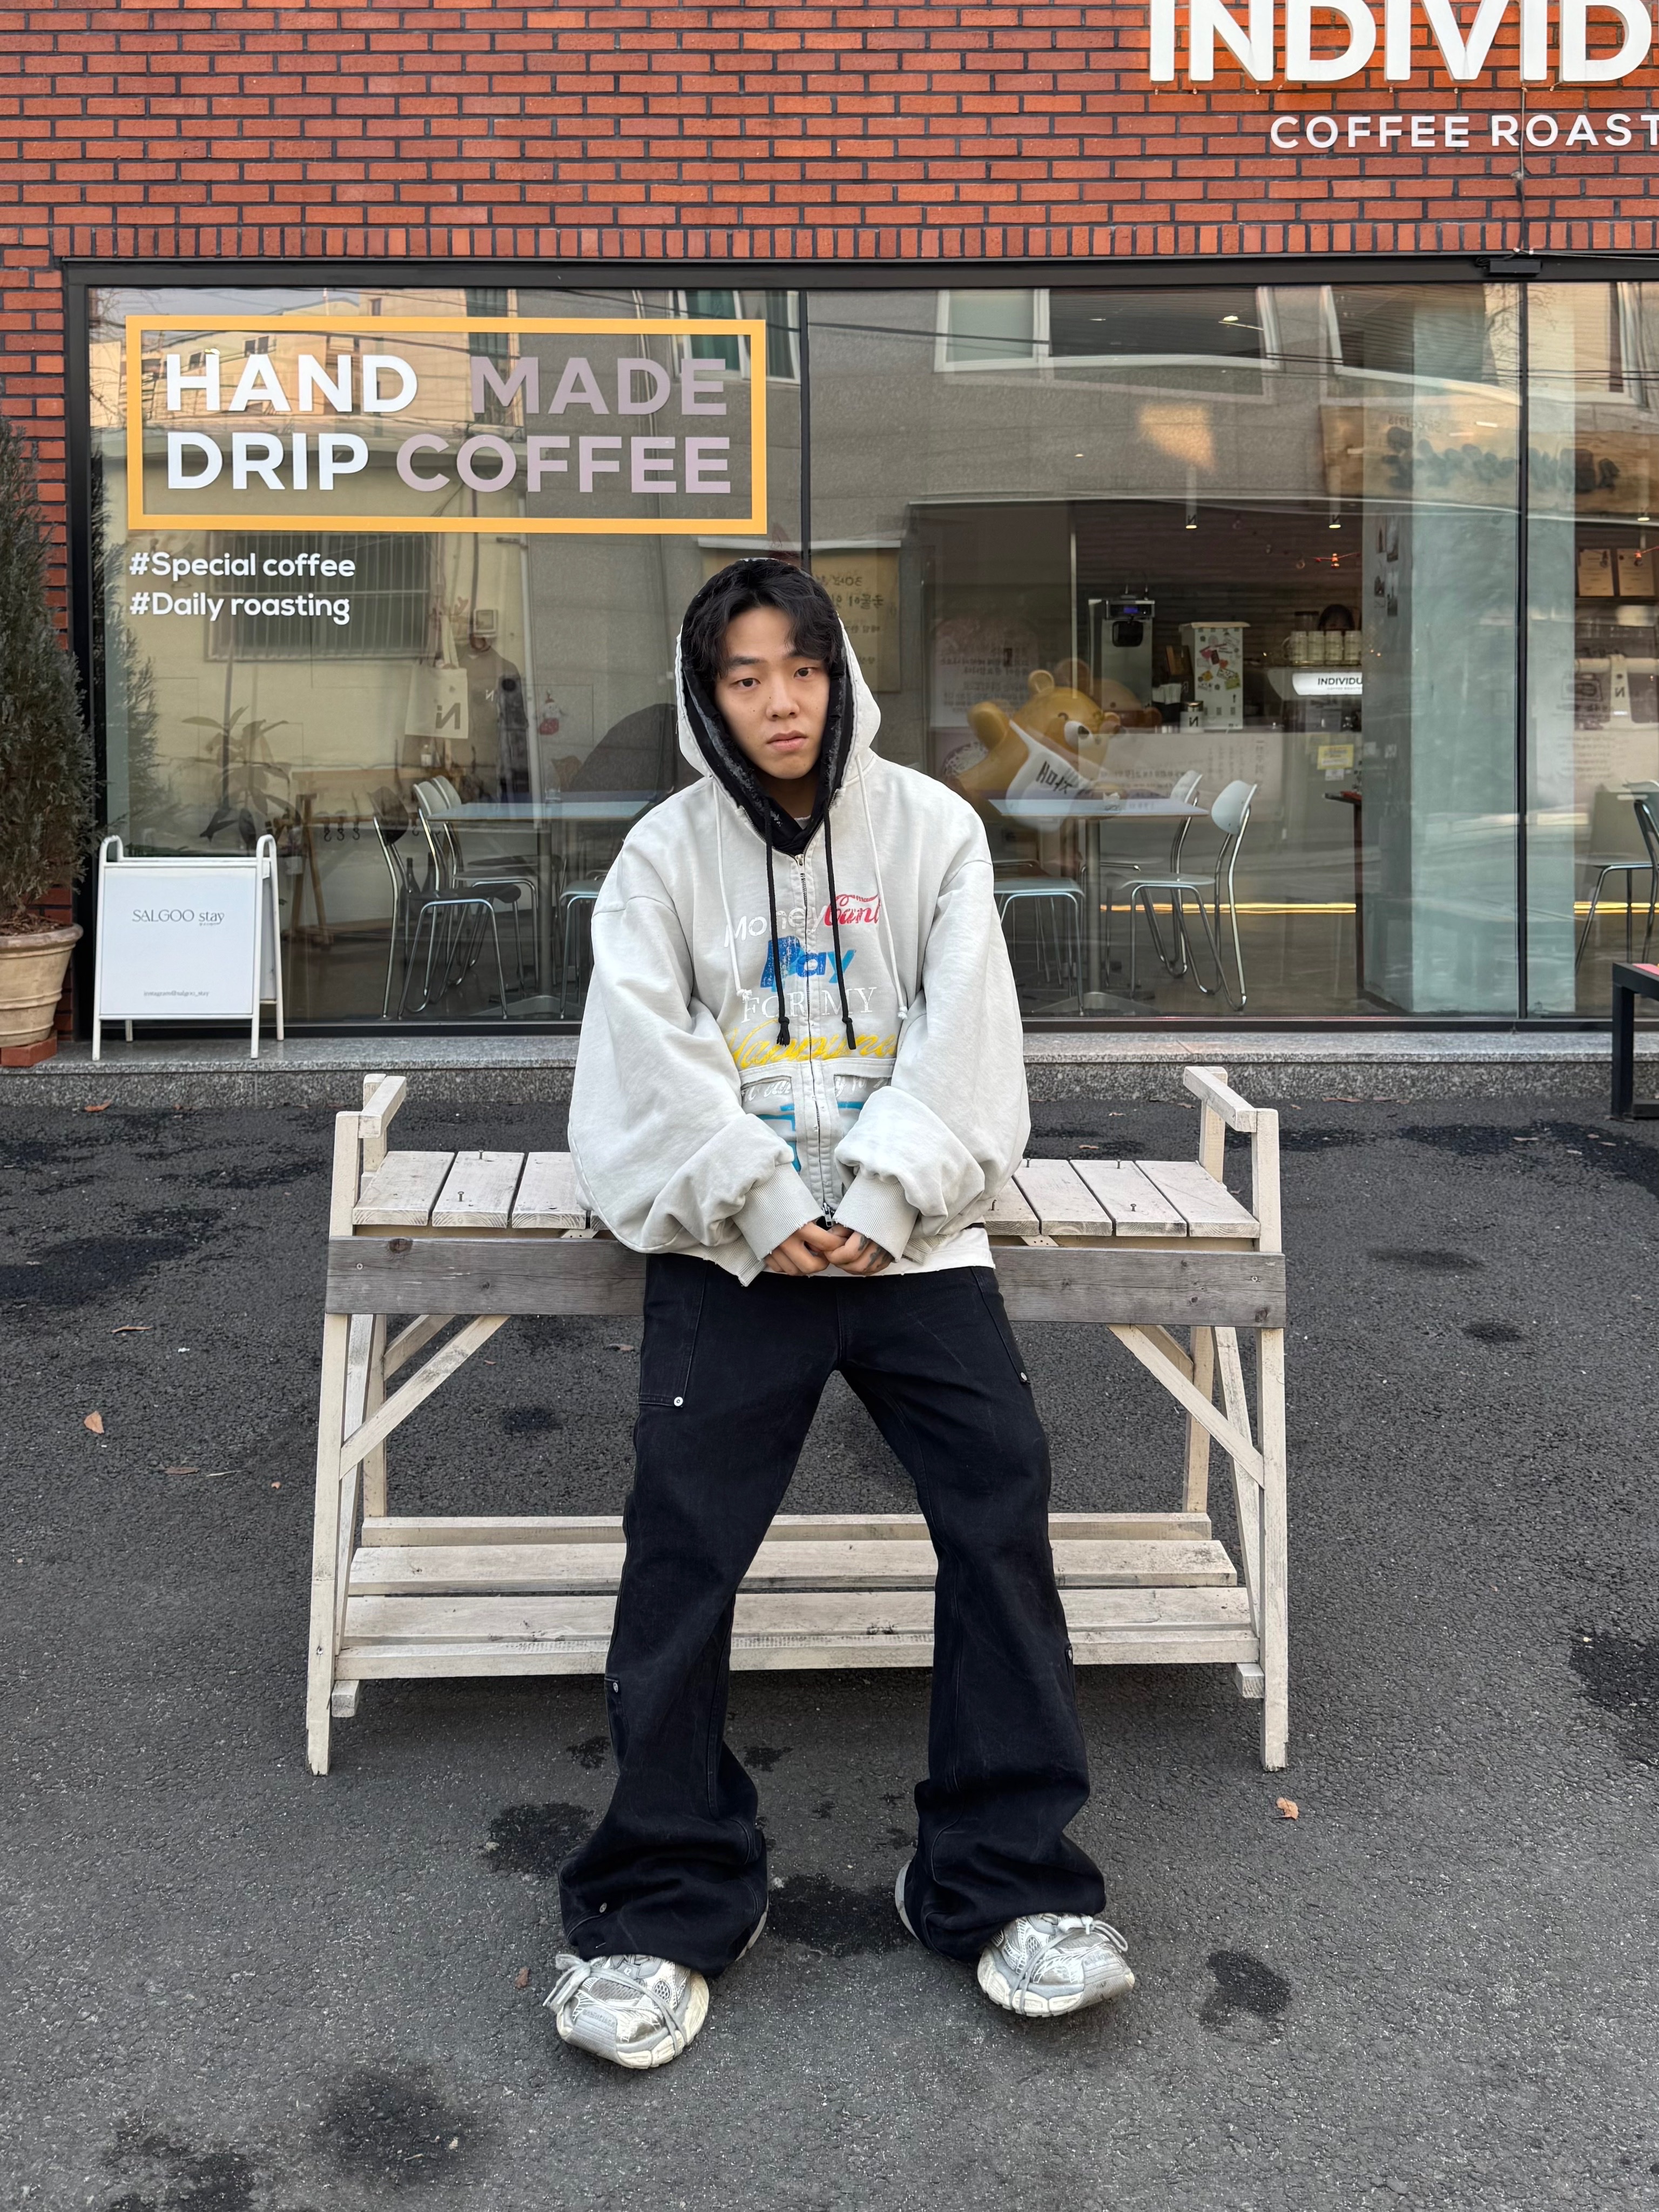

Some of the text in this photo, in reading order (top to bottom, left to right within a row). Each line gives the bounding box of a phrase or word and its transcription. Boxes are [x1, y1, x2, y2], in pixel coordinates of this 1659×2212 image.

[1270, 115, 1469, 149] COFFEE
[166, 354, 727, 415] HAND MADE
[167, 432, 731, 493] DRIP COFFEE
[130, 552, 355, 581] #Special coffee
[130, 592, 350, 625] #Daily roasting
[132, 909, 225, 925] SALGOO stay
[760, 935, 857, 992] Pay
[821, 986, 878, 1016] MY
